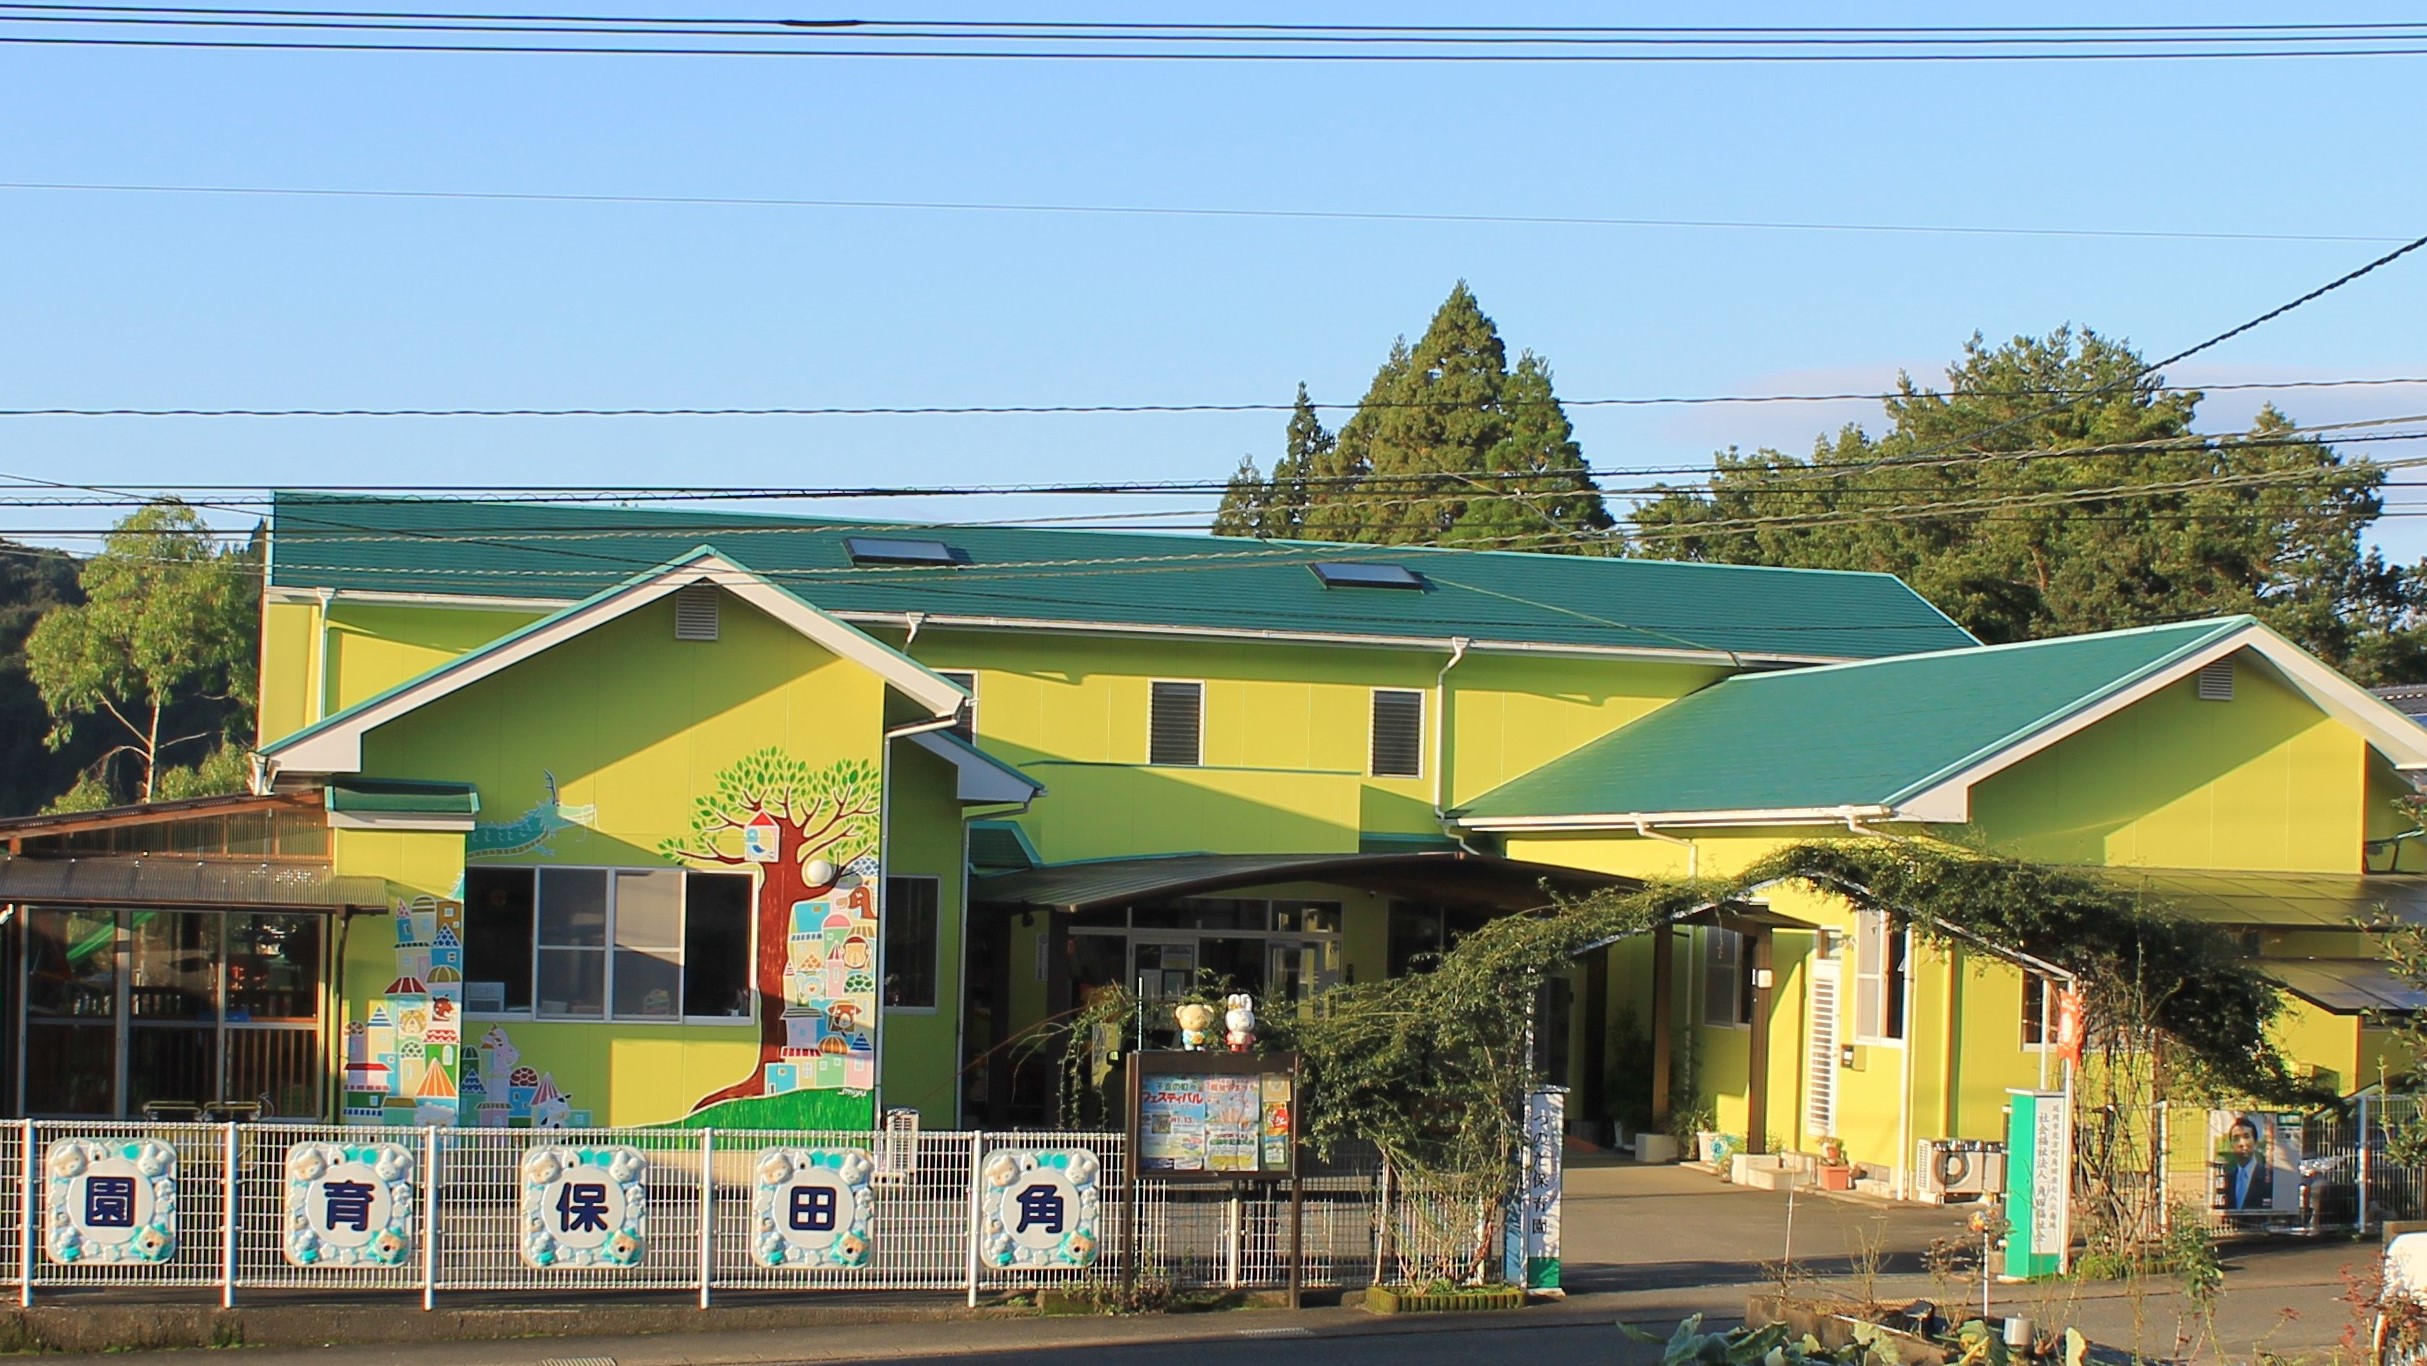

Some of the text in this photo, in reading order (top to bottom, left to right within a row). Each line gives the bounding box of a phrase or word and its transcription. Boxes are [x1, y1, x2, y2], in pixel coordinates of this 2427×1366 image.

[1143, 1092, 1203, 1105] フェスティバル
[1532, 1115, 1548, 1234] つのた保育園
[2037, 1113, 2049, 1179] 社会福祉法人
[85, 1176, 1065, 1235] 園 育 保 田 角
